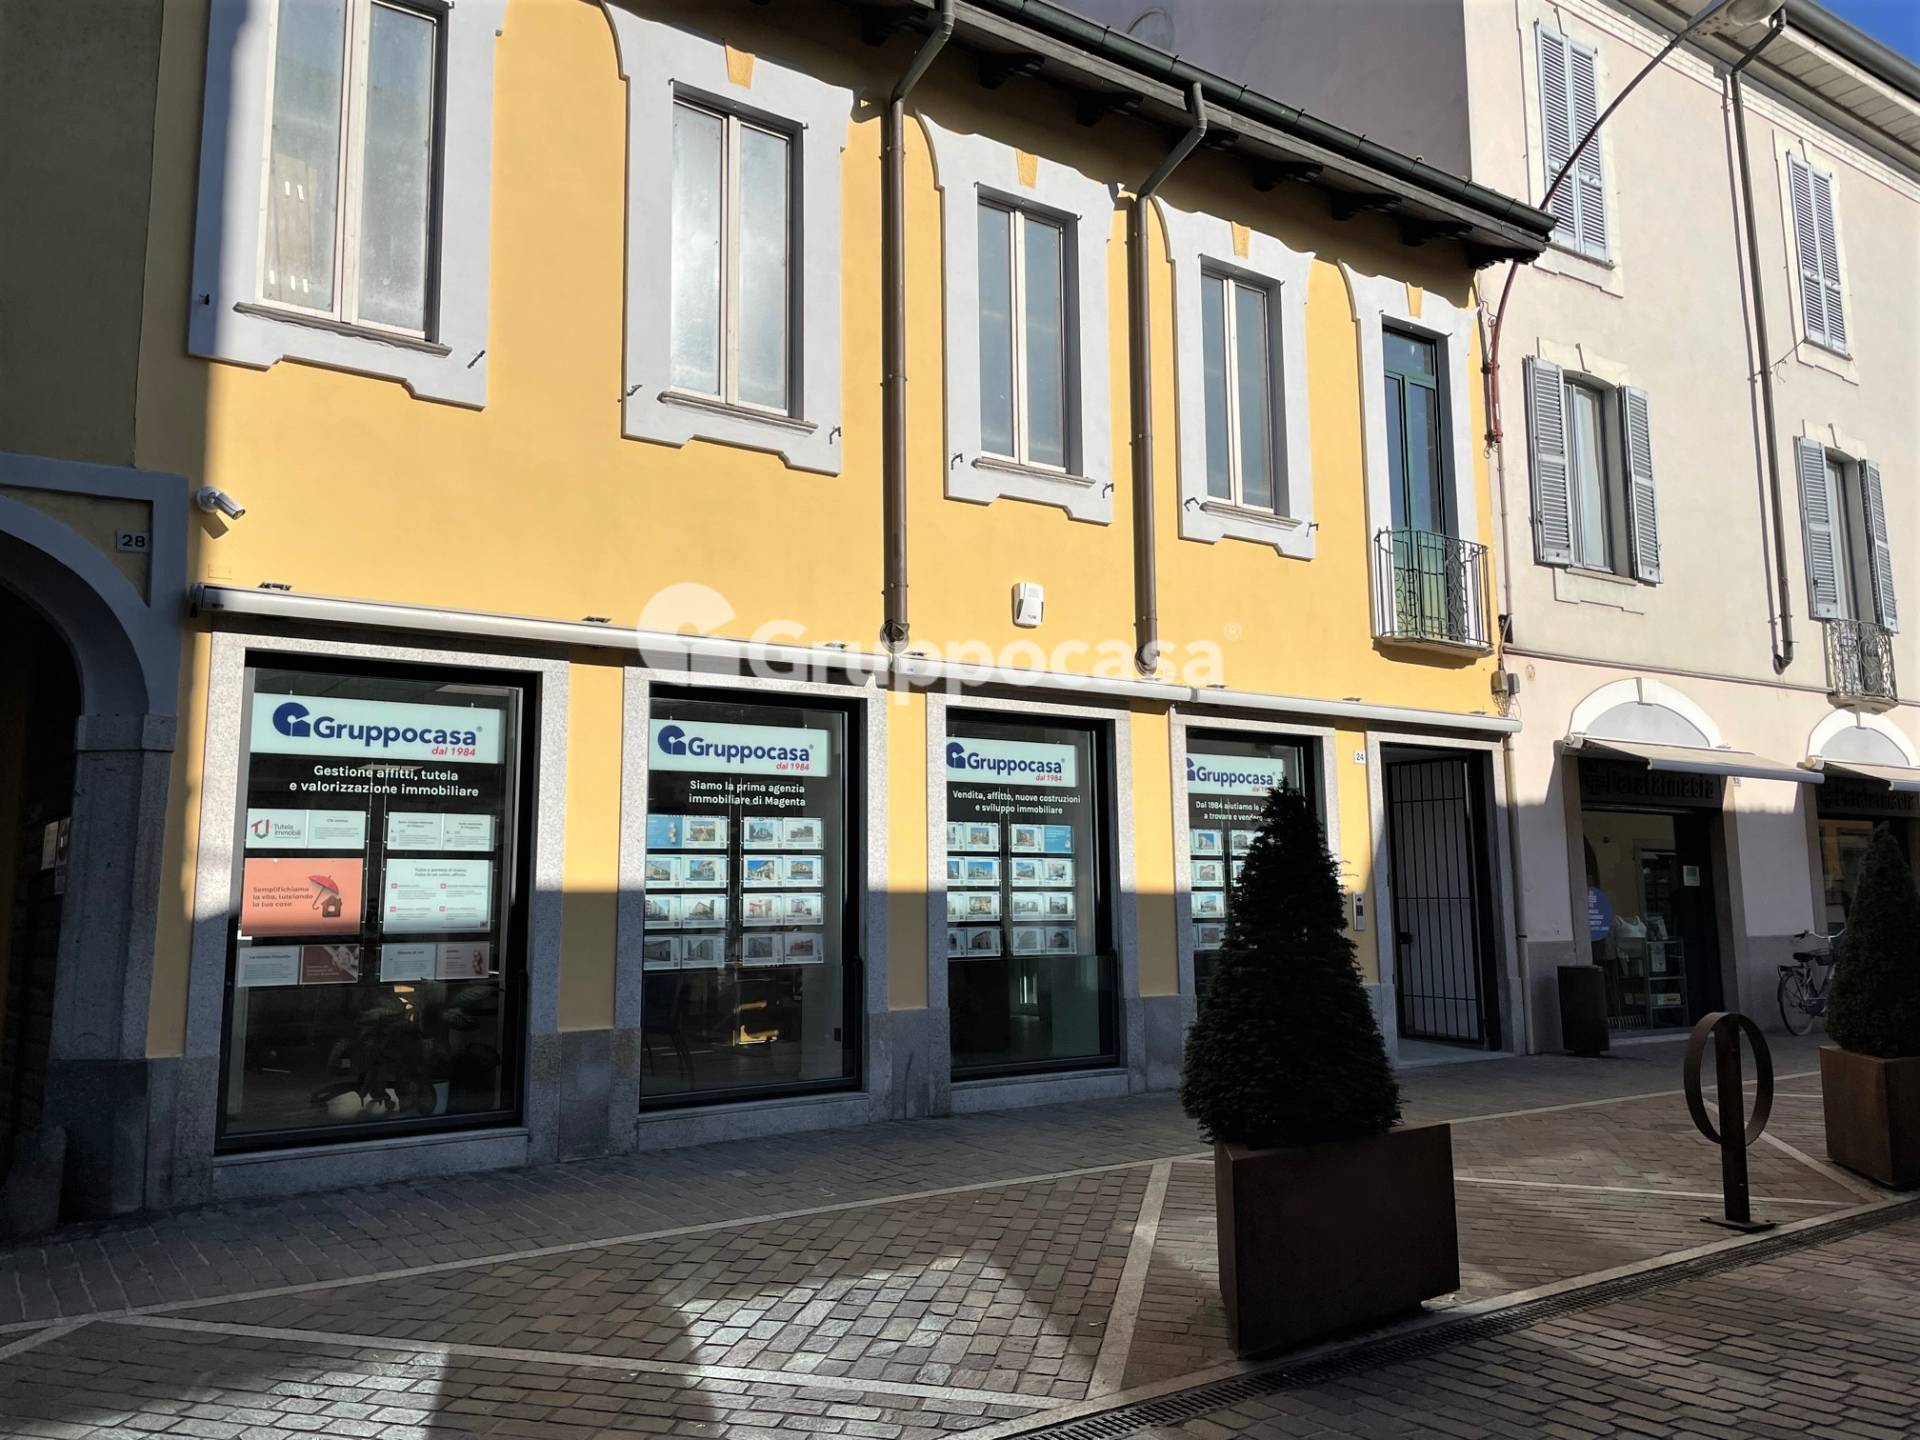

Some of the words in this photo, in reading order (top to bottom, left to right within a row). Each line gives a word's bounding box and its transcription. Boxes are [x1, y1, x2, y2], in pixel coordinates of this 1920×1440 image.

[122, 534, 145, 548] 28
[314, 716, 476, 748] Gruppocasa
[431, 746, 448, 756] dal
[451, 747, 476, 757] 1984
[688, 737, 810, 763] Gruppocasa
[1356, 753, 1364, 761] 24
[776, 762, 789, 770] dal
[791, 763, 810, 771] 1984
[967, 752, 1062, 775] Gruppocasa
[313, 765, 373, 778] Gestione
[376, 767, 419, 781] affitti,
[421, 769, 458, 781] tutela
[1196, 766, 1273, 788] Gruppocasa
[289, 783, 297, 791] e
[300, 780, 398, 794] valorizzazione
[401, 782, 479, 797] immobiliare
[690, 780, 723, 790] Siamo
[725, 781, 734, 791] la
[737, 782, 766, 793] prima
[768, 784, 805, 795] agenzia
[689, 794, 750, 805] immobiliare
[753, 795, 762, 805] di
[765, 796, 806, 808] Magenta
[953, 789, 986, 800] Vendita,
[987, 791, 1014, 801] affitto,
[1015, 794, 1038, 802] nuove
[1039, 794, 1081, 803] costruzioni
[982, 803, 1015, 814] sviluppo
[1016, 804, 1063, 814] immobiliare
[1224, 802, 1253, 811] aiutiamo
[1209, 812, 1232, 821] trovare
